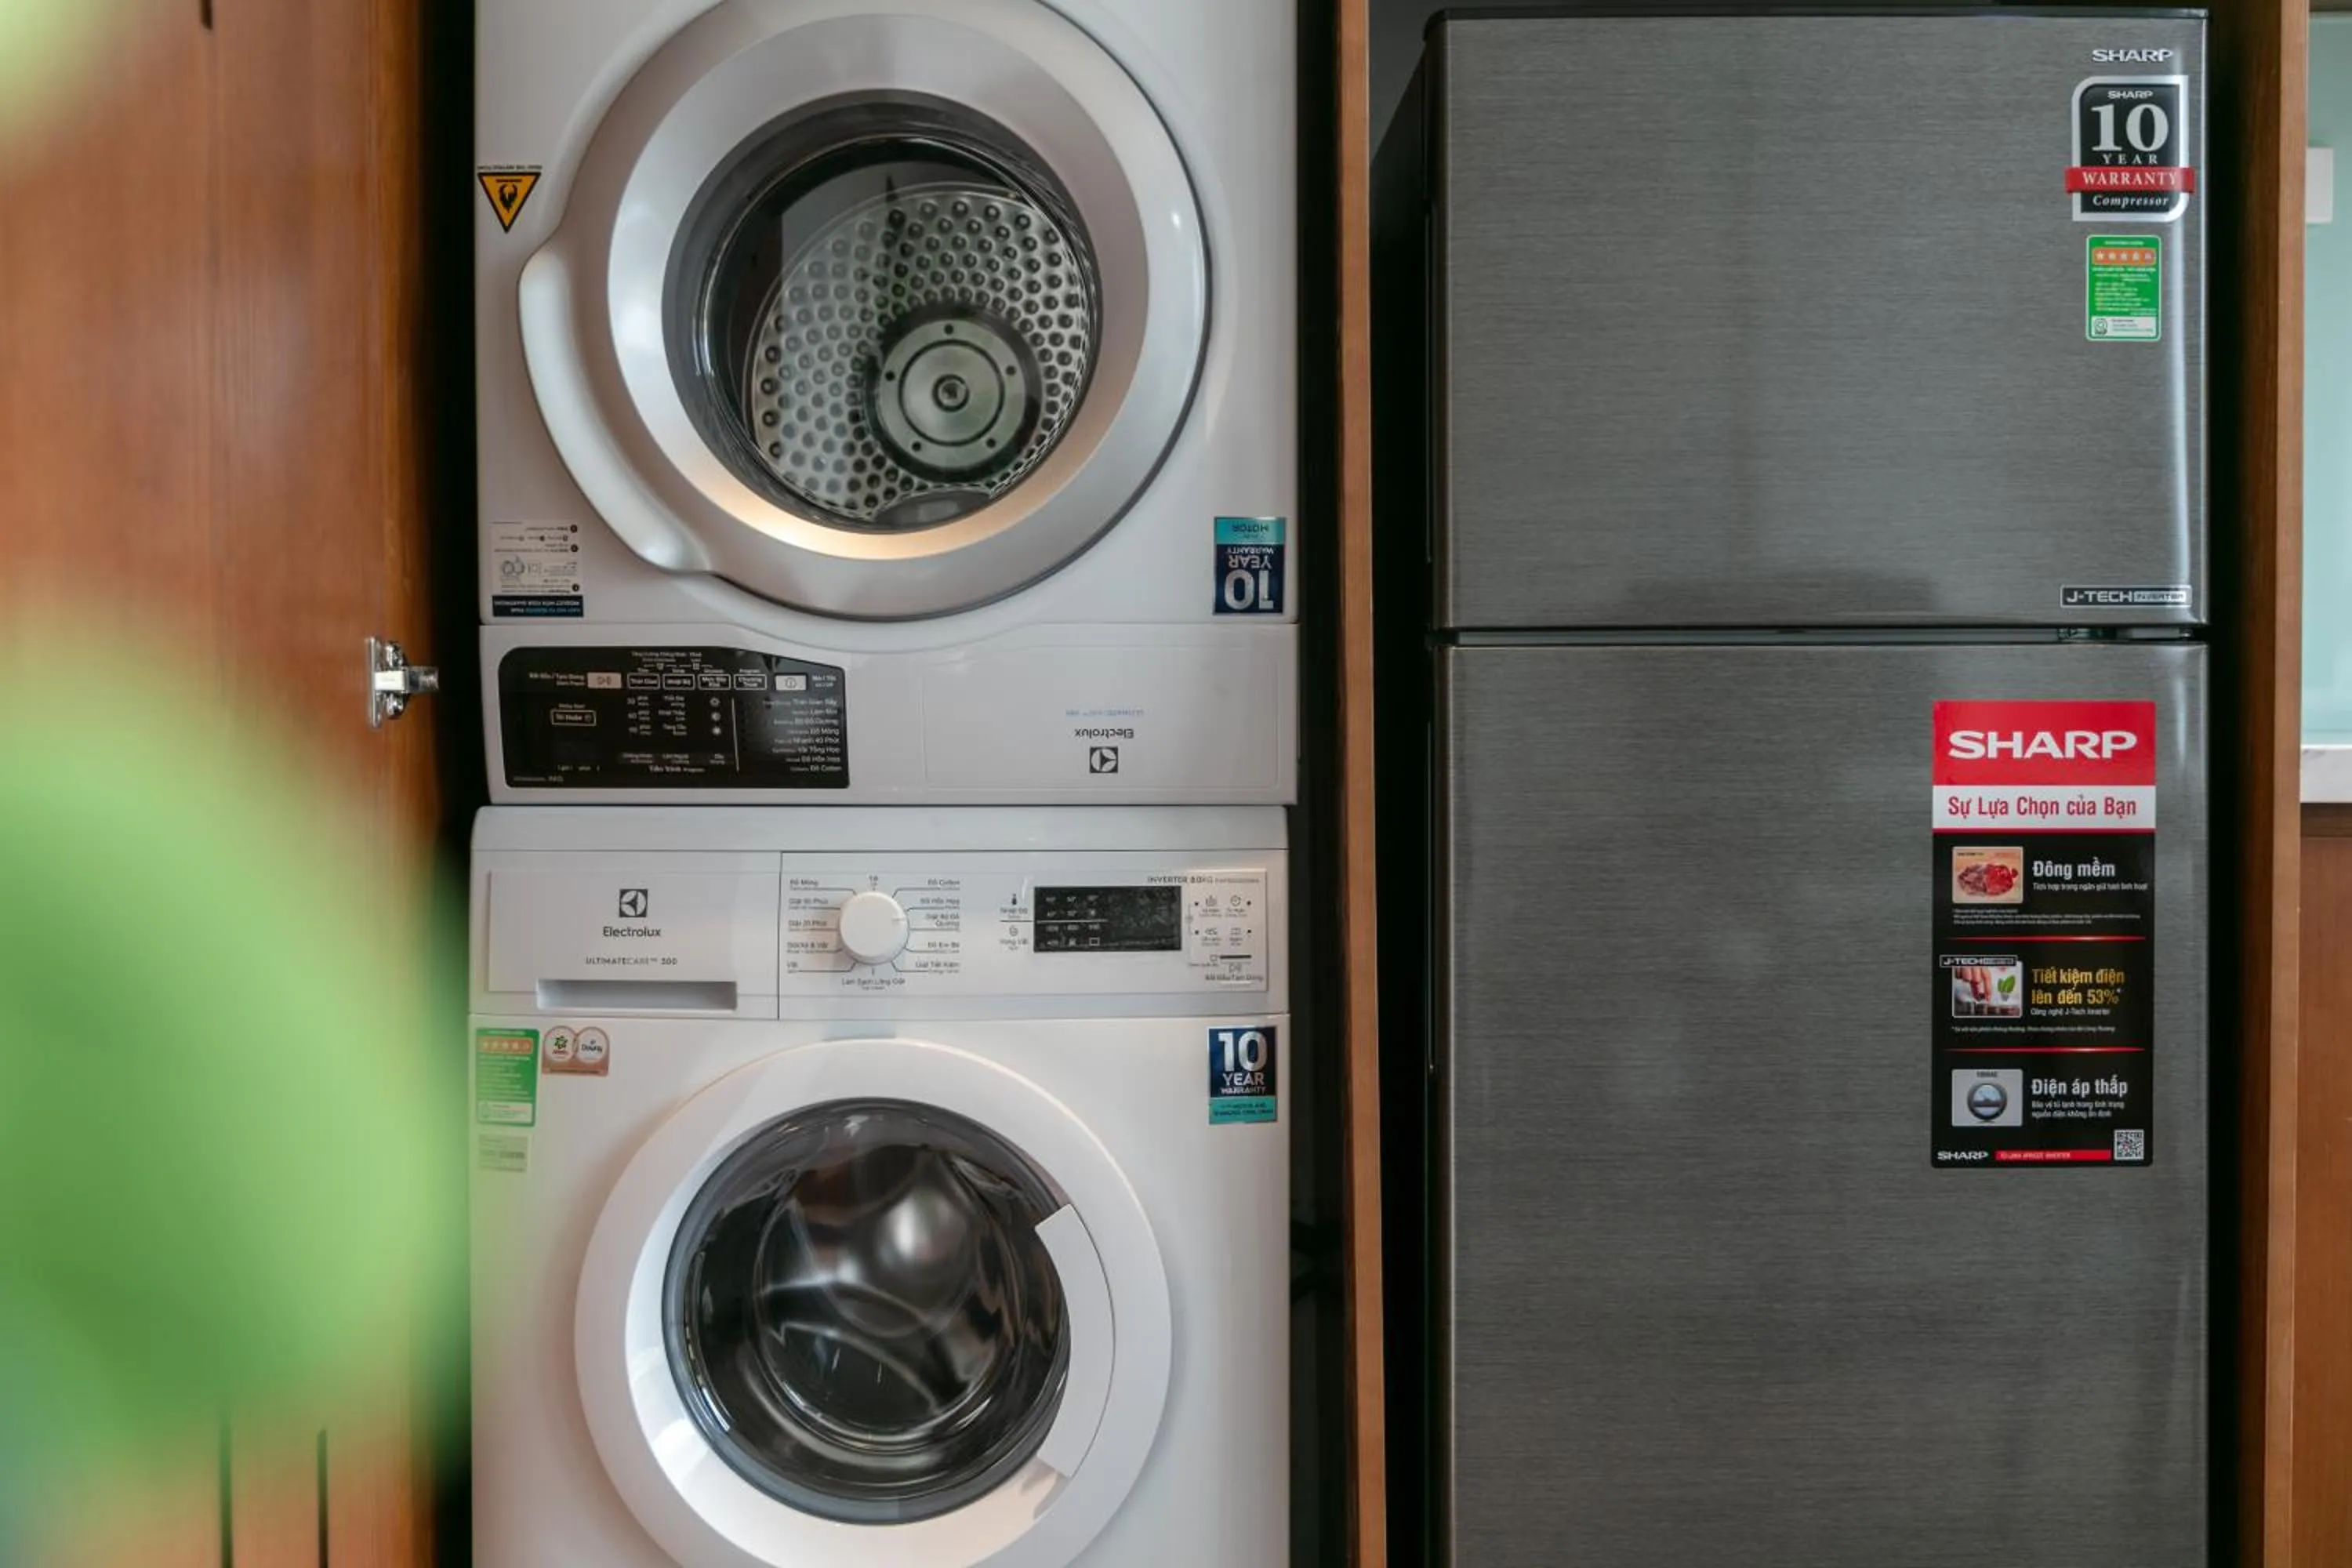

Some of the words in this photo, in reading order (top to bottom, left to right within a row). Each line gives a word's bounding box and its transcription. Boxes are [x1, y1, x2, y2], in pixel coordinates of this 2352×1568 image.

[2092, 49, 2173, 62] SHARP
[2107, 90, 2154, 99] SHARP
[2090, 103, 2169, 152] 10
[2102, 154, 2158, 165] YEAR
[2082, 172, 2177, 186] WARRANTY
[2092, 194, 2169, 209] Compressor
[1229, 555, 1272, 569] YEAR
[1225, 569, 1274, 610] 10
[2066, 590, 2132, 603] J-TECH
[1074, 728, 1134, 739] Electrolux
[1948, 730, 2138, 759] SHARP
[1948, 797, 1973, 819] Sự
[1978, 797, 2009, 819] Lựa
[2016, 796, 2059, 819] Chọn
[2067, 794, 2096, 815] của
[2104, 796, 2136, 819] Bạn
[2032, 860, 2072, 880] Đông
[2078, 856, 2115, 877] mềm
[603, 926, 662, 938] Electrolux
[2031, 967, 2056, 984] Tiết
[2060, 967, 2092, 985] kiệm
[2096, 968, 2125, 985] điện
[2031, 989, 2053, 1004] lên
[2057, 985, 2082, 1004] đến
[1218, 1031, 1268, 1072] 10
[1222, 1073, 1265, 1086] YEAR
[2031, 1078, 2067, 1098] Điện
[2072, 1078, 2089, 1098] áp
[2094, 1074, 2129, 1098] thấp
[1221, 1086, 1267, 1094] WARRANTY
[1937, 1151, 1989, 1160] SHARP
